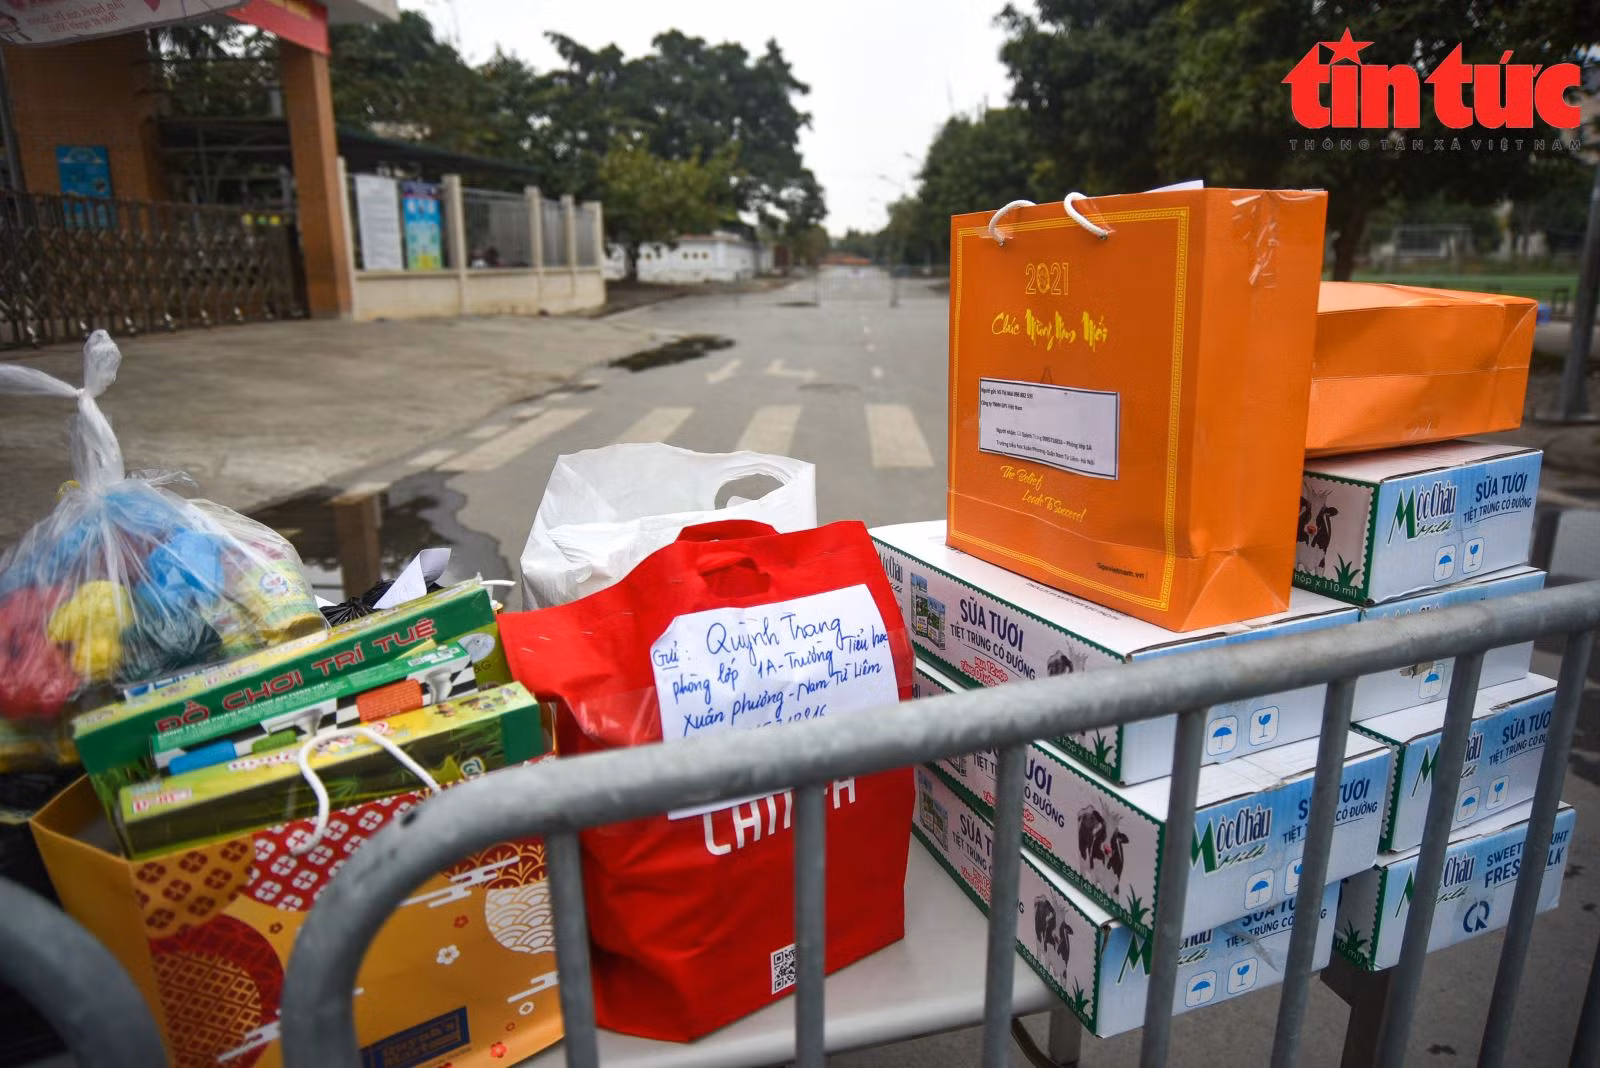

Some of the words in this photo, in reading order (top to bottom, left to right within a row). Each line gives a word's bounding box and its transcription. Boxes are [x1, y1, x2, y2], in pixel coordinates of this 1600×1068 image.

[1025, 262, 1069, 295] 2021
[991, 312, 1020, 335] Chúc
[1475, 475, 1498, 503] SỮA
[1501, 473, 1528, 495] TƯƠI
[1463, 509, 1478, 525] TIỆT
[1479, 502, 1500, 519] TRÙNG
[1501, 500, 1511, 512] CÓ
[1511, 496, 1532, 510] ĐƯỜNG
[1416, 520, 1452, 538] Milk
[1315, 579, 1321, 588] x
[1324, 580, 1340, 593] 110
[1342, 587, 1358, 600] ml)
[706, 616, 780, 667] Quỳnh
[780, 612, 845, 650] Trang
[960, 596, 986, 630] SỮA
[988, 610, 1024, 652] TƯƠI
[950, 621, 965, 645] TIỆT
[966, 627, 991, 652] TRÙNG
[993, 643, 1005, 665] CÓ
[1006, 651, 1036, 681] ĐƯỜNG
[157, 700, 210, 733] ĐỒ
[222, 671, 304, 711] CHƠI
[311, 644, 366, 678] TRÍ
[373, 617, 439, 655] TUỆ
[672, 672, 711, 704] phòng
[717, 656, 740, 690] lớp
[1502, 718, 1526, 745] SỮA
[1086, 751, 1098, 766] 110
[1489, 749, 1503, 766] TIỆT
[1506, 740, 1527, 755] TRÙNG
[1528, 735, 1538, 748] CÓ
[1025, 757, 1052, 796] ƯƠI
[1032, 792, 1065, 828] ĐƯỜNG
[1283, 825, 1302, 844] TIỆT
[1335, 805, 1348, 822] CÓ
[1349, 799, 1378, 818] ĐƯỜNG
[960, 813, 983, 850] SỮA
[952, 831, 965, 850] TIỆT
[966, 842, 987, 871] TRÙNG
[1218, 844, 1268, 870] Milk
[1485, 858, 1520, 889] FRES
[1547, 847, 1565, 867] LK
[1443, 853, 1475, 888] Châu
[1120, 909, 1133, 924] 110
